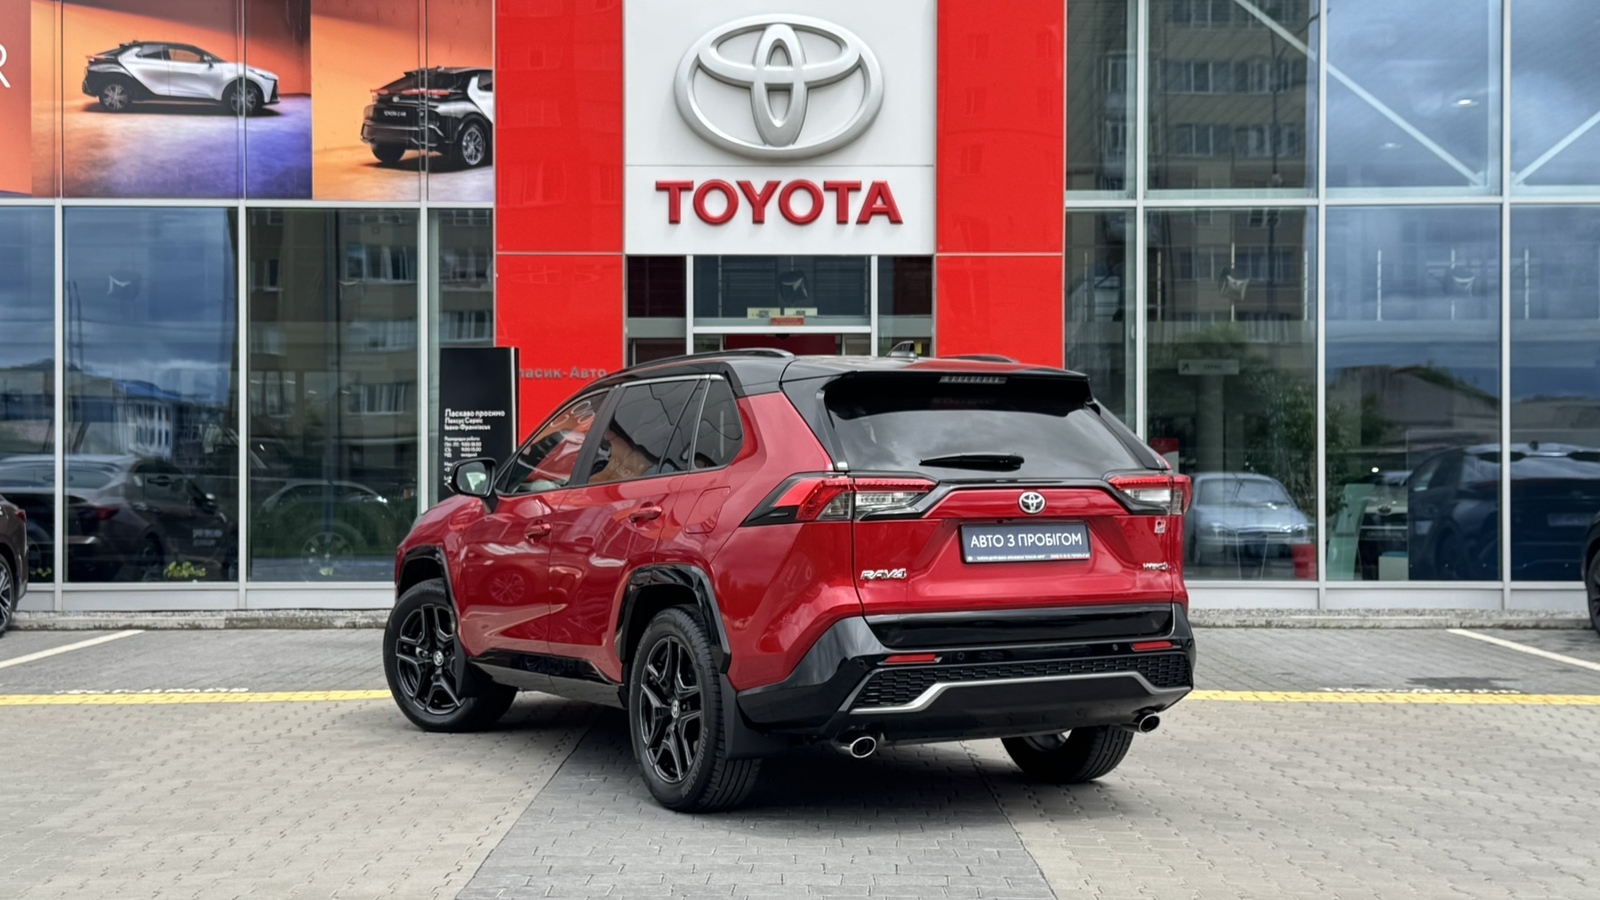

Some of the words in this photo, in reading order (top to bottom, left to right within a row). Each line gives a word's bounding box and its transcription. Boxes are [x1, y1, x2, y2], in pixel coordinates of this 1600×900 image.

[656, 179, 903, 226] TOYOTA
[475, 410, 506, 418] просимо
[970, 534, 1004, 548] АВТО
[1018, 532, 1082, 547] ПРОБІГОМ
[860, 568, 907, 580] RAV4
